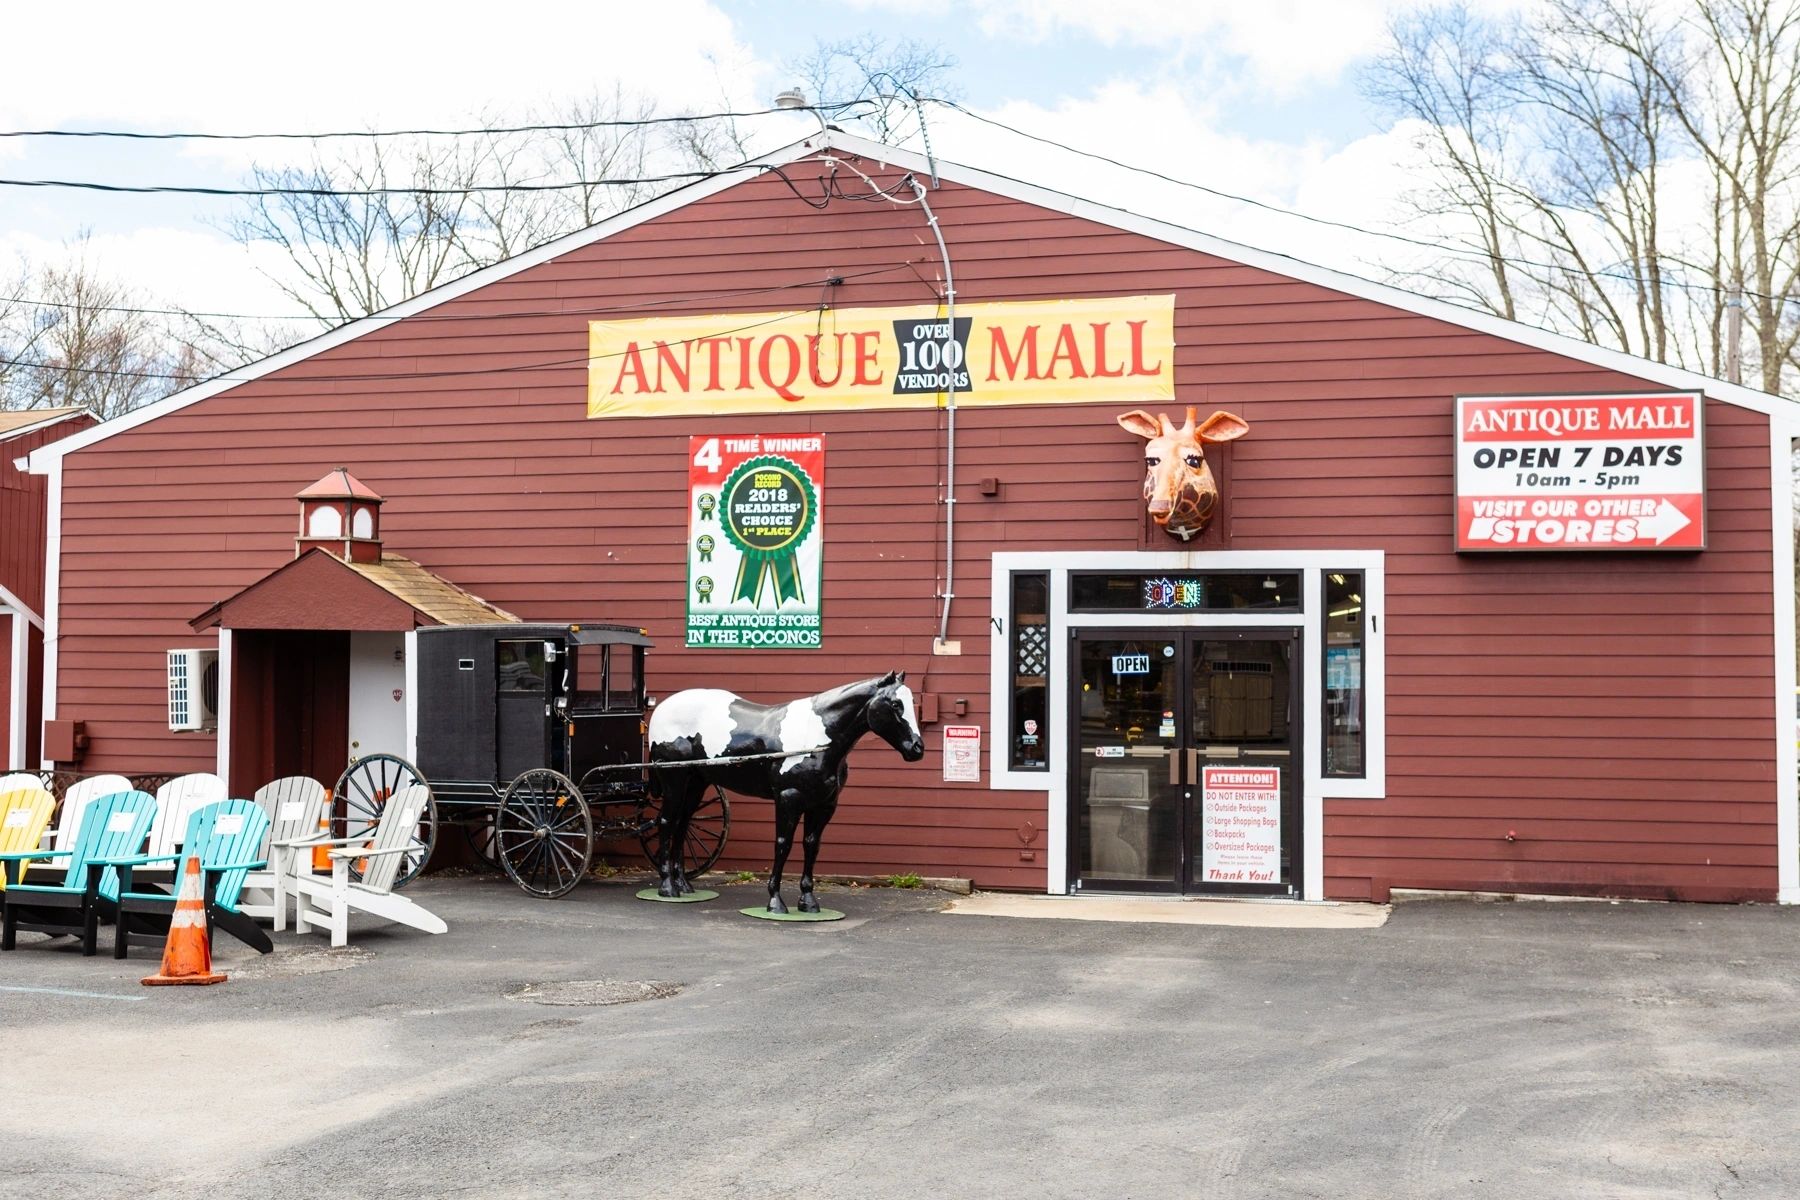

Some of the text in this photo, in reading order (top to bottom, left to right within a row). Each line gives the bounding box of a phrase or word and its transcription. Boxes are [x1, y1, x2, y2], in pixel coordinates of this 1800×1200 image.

[913, 324, 951, 339] OVER
[611, 320, 1162, 402] ANTIQUE MALL
[903, 340, 963, 371] 100
[898, 372, 969, 389] VENDORS
[1467, 405, 1690, 436] ANTIQUE MALL
[693, 438, 822, 473] 4 TIME WINNER
[1473, 445, 1683, 469] OPEN 7 DAYS
[1515, 473, 1571, 487] 10am
[1594, 472, 1640, 489] 5pm
[748, 489, 788, 502] 2018
[1472, 499, 1658, 518] VISIT OUR OTHER
[741, 516, 793, 526] CHOICE
[756, 527, 792, 536] PLACE
[1490, 519, 1640, 544] STORES
[1152, 584, 1197, 603] OPEN
[688, 614, 820, 628] BEST ANTIQUE STORE
[687, 630, 820, 645] IN THE POCONOS
[1116, 657, 1147, 672] OPEN
[1210, 774, 1274, 784] ATTENTION!
[1206, 791, 1216, 800] DO
[1218, 791, 1233, 800] NOT
[1235, 792, 1256, 801] ENTER
[1214, 802, 1267, 814] Outside Packages
[1214, 816, 1277, 828] Large Shopping Bags
[1214, 829, 1246, 839] Backpacks
[1214, 841, 1275, 853] Oversized Packages
[1209, 869, 1274, 881] Thank You!
